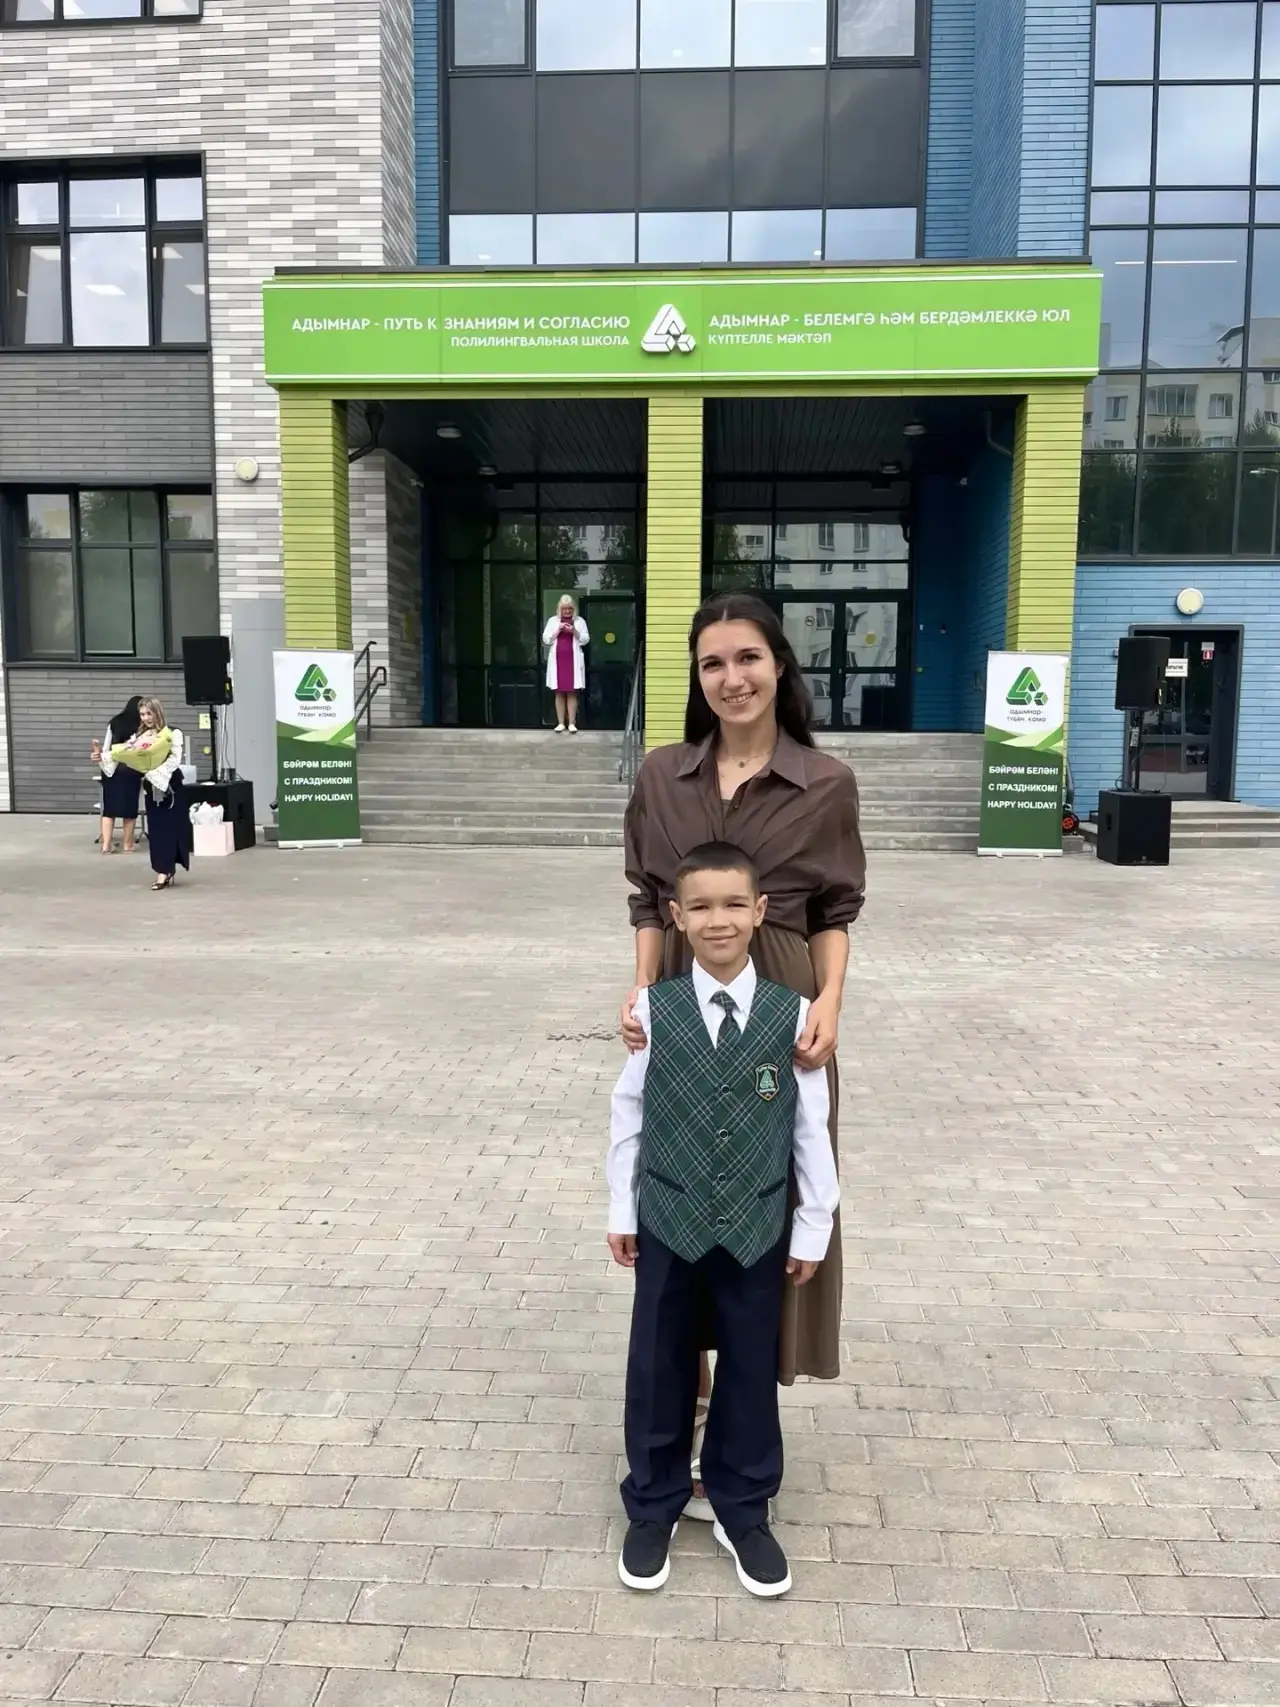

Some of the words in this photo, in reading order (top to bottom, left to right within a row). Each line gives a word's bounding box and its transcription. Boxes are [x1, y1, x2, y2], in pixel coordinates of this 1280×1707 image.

[292, 317, 371, 332] АДЫМНАР
[383, 317, 423, 330] ПУТЬ
[427, 317, 437, 330] К
[444, 317, 519, 330] ЗНАНИЯМ
[524, 317, 534, 329] И
[539, 316, 630, 329] СОГЛАСИЮ
[709, 314, 790, 329] АДЫМНАР
[804, 313, 875, 326] БЕЛЕМГӘ
[919, 310, 1037, 326] БЕРДӘМЛЕККӘ
[1042, 309, 1070, 322] ЮЛ
[451, 336, 578, 347] ПОЛИЛИНГВАЛЬНАЯ
[582, 335, 630, 346] ШКОЛА
[708, 333, 772, 344] КҮПТЕЛЛЕ
[777, 333, 832, 344] МӘКТӘП
[988, 765, 1025, 774] БӘЙРӘМ
[1026, 766, 1058, 775] БЕЛӘН!
[292, 777, 353, 786] ПРАЗДНИКОМ!
[988, 783, 995, 791] С
[996, 783, 1058, 792] ПРАЗДНИКОМ!
[284, 794, 313, 802] HAPPY
[314, 793, 353, 801] HOLIDAY!
[1017, 801, 1057, 809] HOLIDAY!
